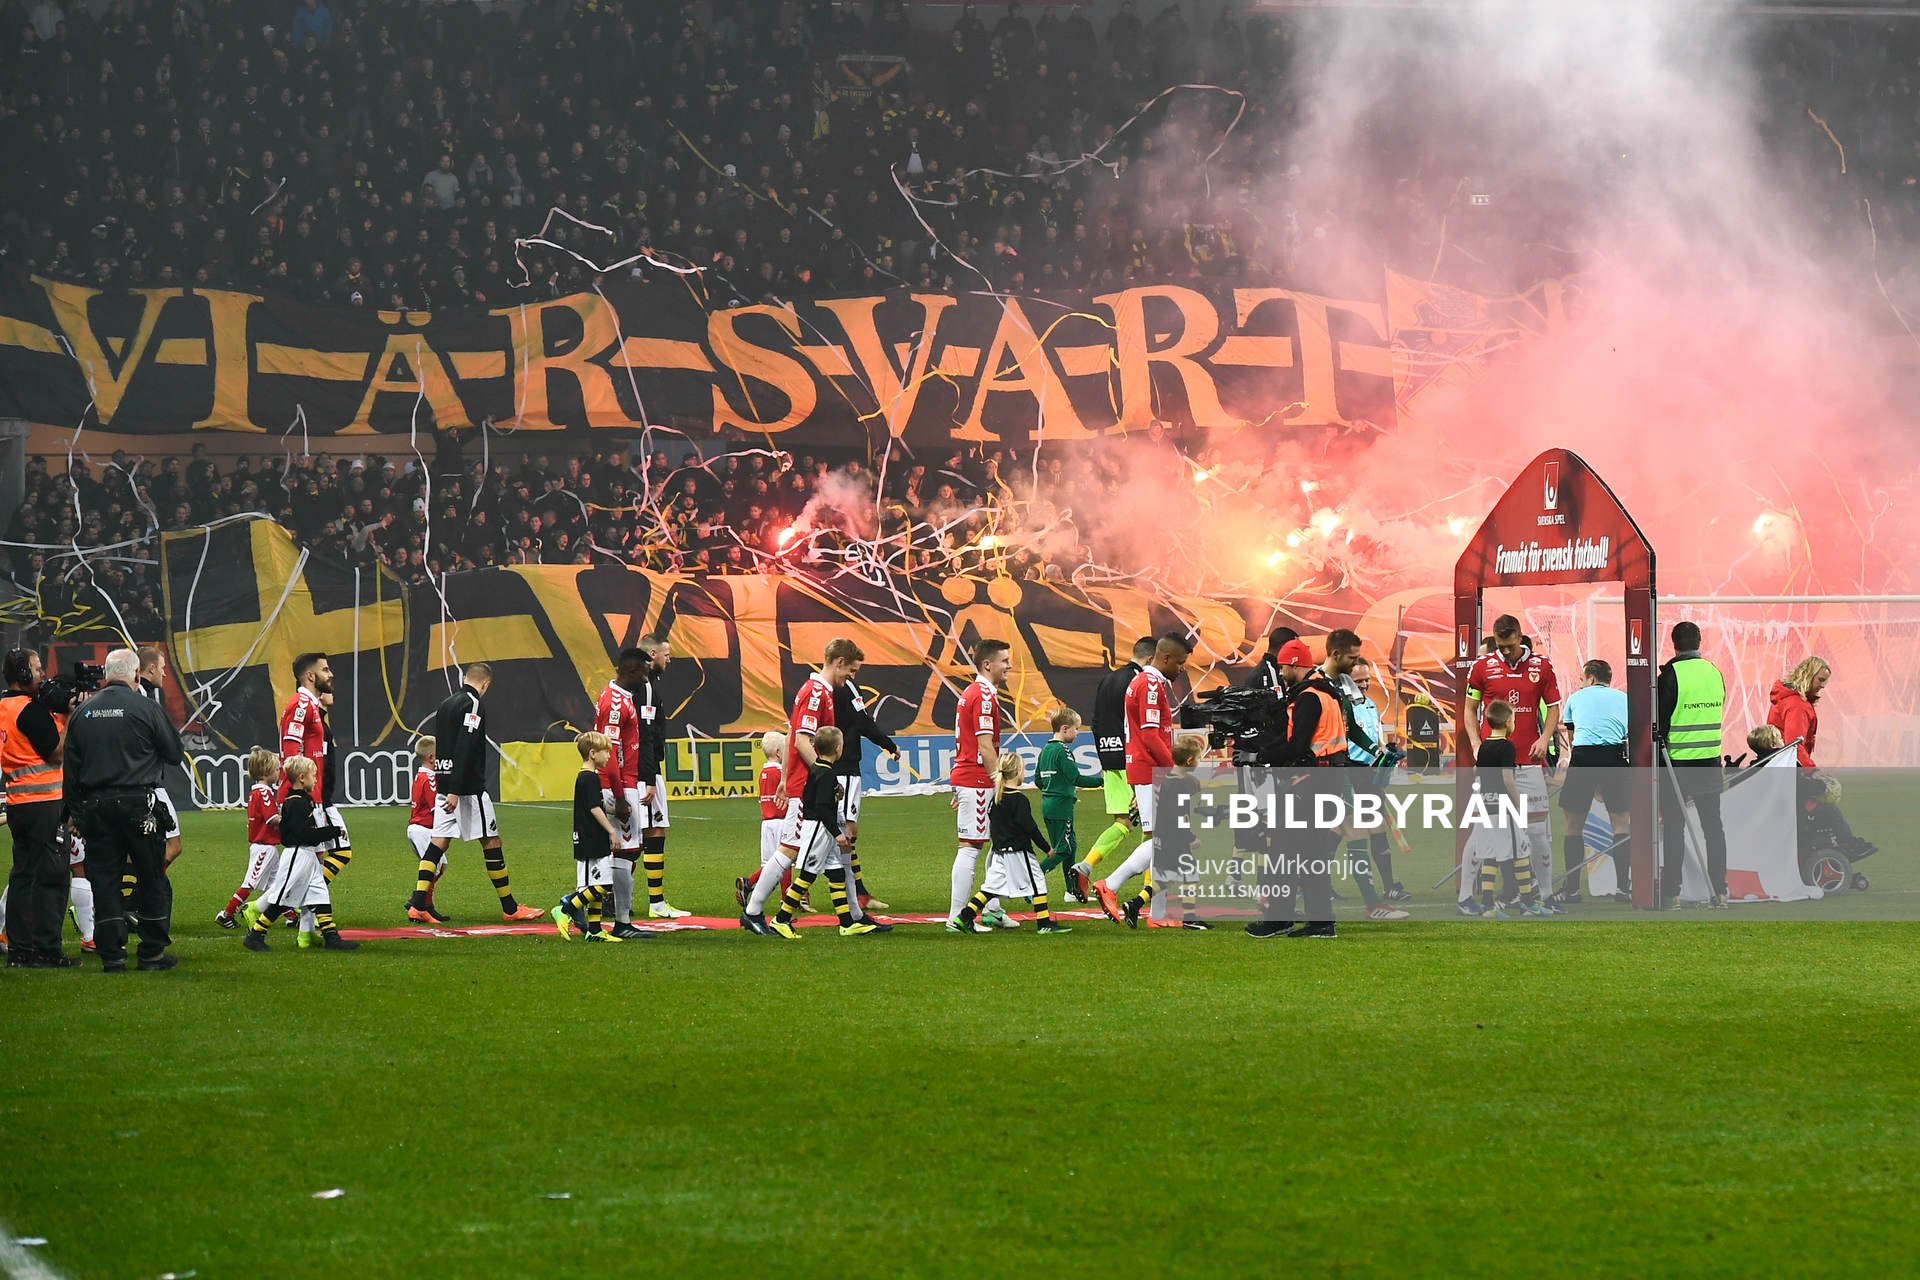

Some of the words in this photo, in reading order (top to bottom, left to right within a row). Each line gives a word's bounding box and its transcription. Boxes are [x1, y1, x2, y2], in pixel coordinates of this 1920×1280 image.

[30, 274, 267, 434] VI
[333, 291, 641, 435] ÄR
[707, 284, 1390, 441] SVART
[1495, 541, 1528, 574] Framåt
[1528, 541, 1543, 573] för
[1542, 538, 1574, 572] svensk
[1574, 536, 1609, 570] fotboll!
[499, 564, 792, 734] VI
[664, 741, 753, 782] LTE
[1100, 736, 1123, 748] SVEA
